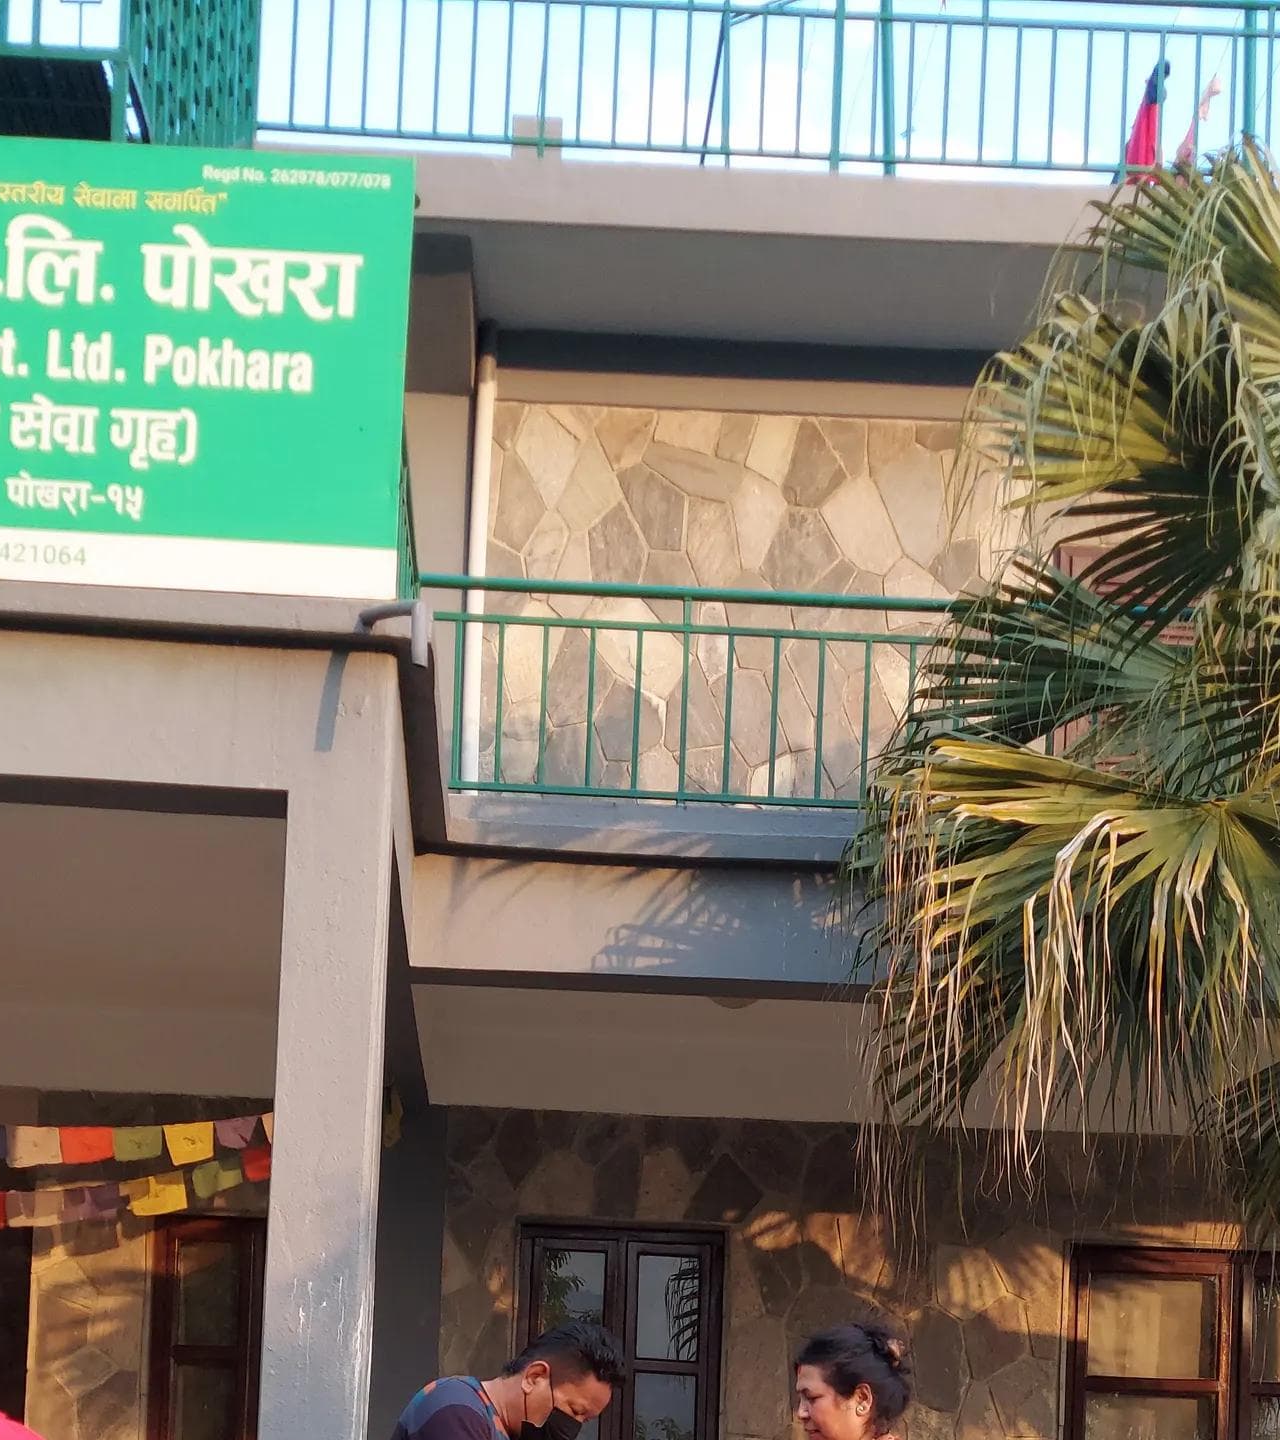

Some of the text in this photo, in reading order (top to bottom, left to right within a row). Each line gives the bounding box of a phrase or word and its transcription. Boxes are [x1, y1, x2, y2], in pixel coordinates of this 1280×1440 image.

[141, 223, 365, 321] पोखरा
[46, 328, 126, 383] Ltd.
[144, 333, 315, 394] Pokhara
[10, 393, 100, 454] सेवा
[110, 406, 198, 469] गृह)
